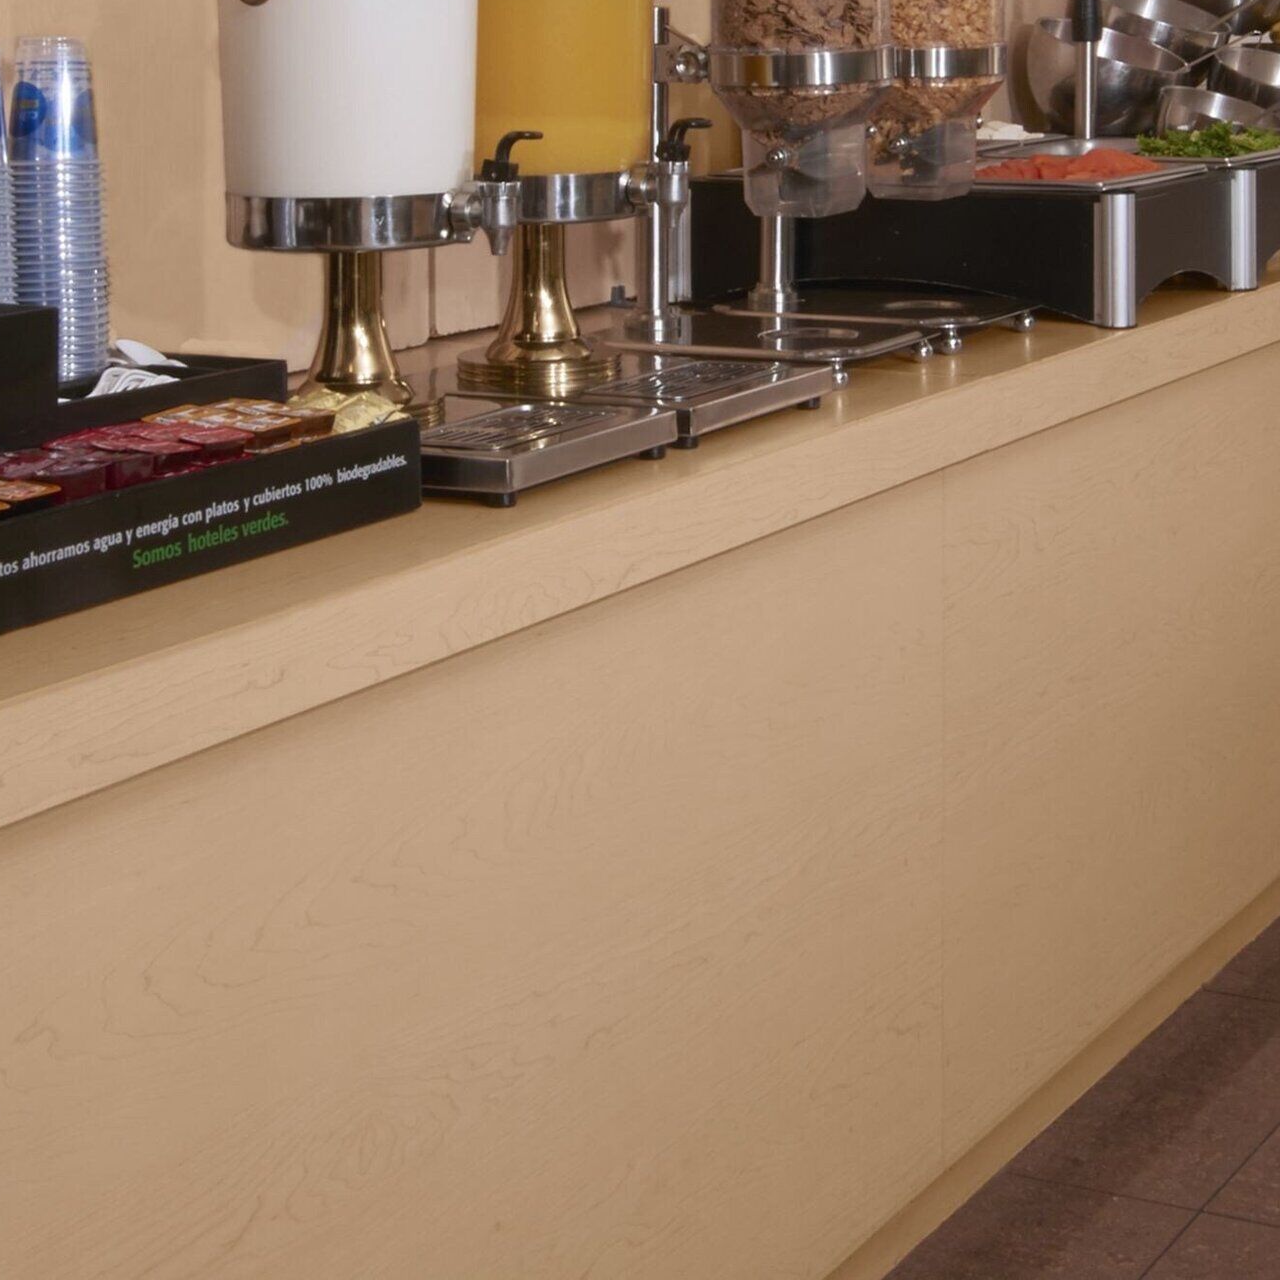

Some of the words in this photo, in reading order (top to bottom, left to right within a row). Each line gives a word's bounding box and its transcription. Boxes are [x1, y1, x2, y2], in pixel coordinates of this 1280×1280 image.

[21, 540, 91, 571] ahorramos
[92, 530, 123, 553] agua
[125, 529, 134, 547] y
[135, 513, 179, 539] energía
[182, 507, 203, 526] con
[205, 499, 240, 524] platos
[243, 495, 252, 513] y
[252, 481, 302, 507] cubiertos
[304, 472, 333, 492] 100%
[336, 453, 408, 484] biodegradables.
[132, 538, 183, 570] Somos
[187, 524, 239, 554] hoteles
[241, 511, 290, 538] verdes.
